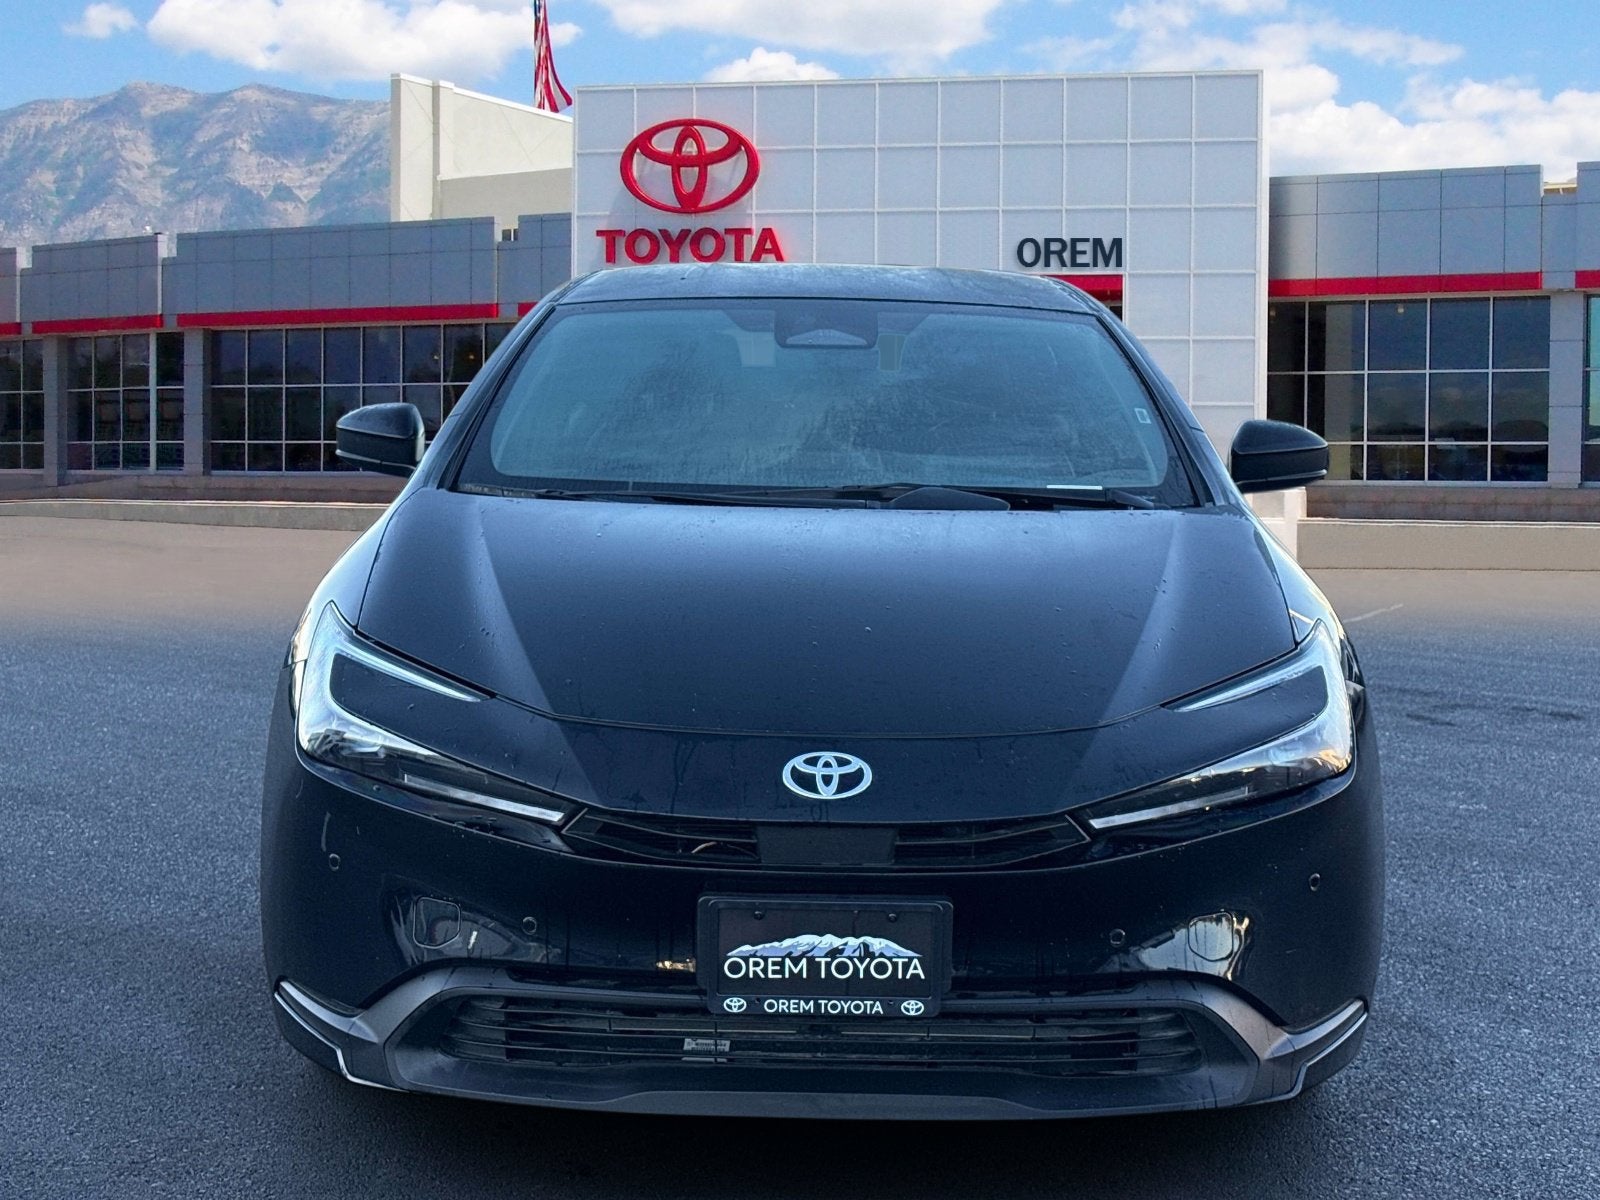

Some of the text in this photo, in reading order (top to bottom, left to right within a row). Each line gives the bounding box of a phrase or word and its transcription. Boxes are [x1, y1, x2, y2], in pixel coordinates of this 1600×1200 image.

[596, 227, 784, 263] TOYOTA
[1017, 237, 1123, 268] OREM
[723, 957, 925, 979] OREM TOYOTA
[763, 999, 883, 1014] OREM TOYOTA
